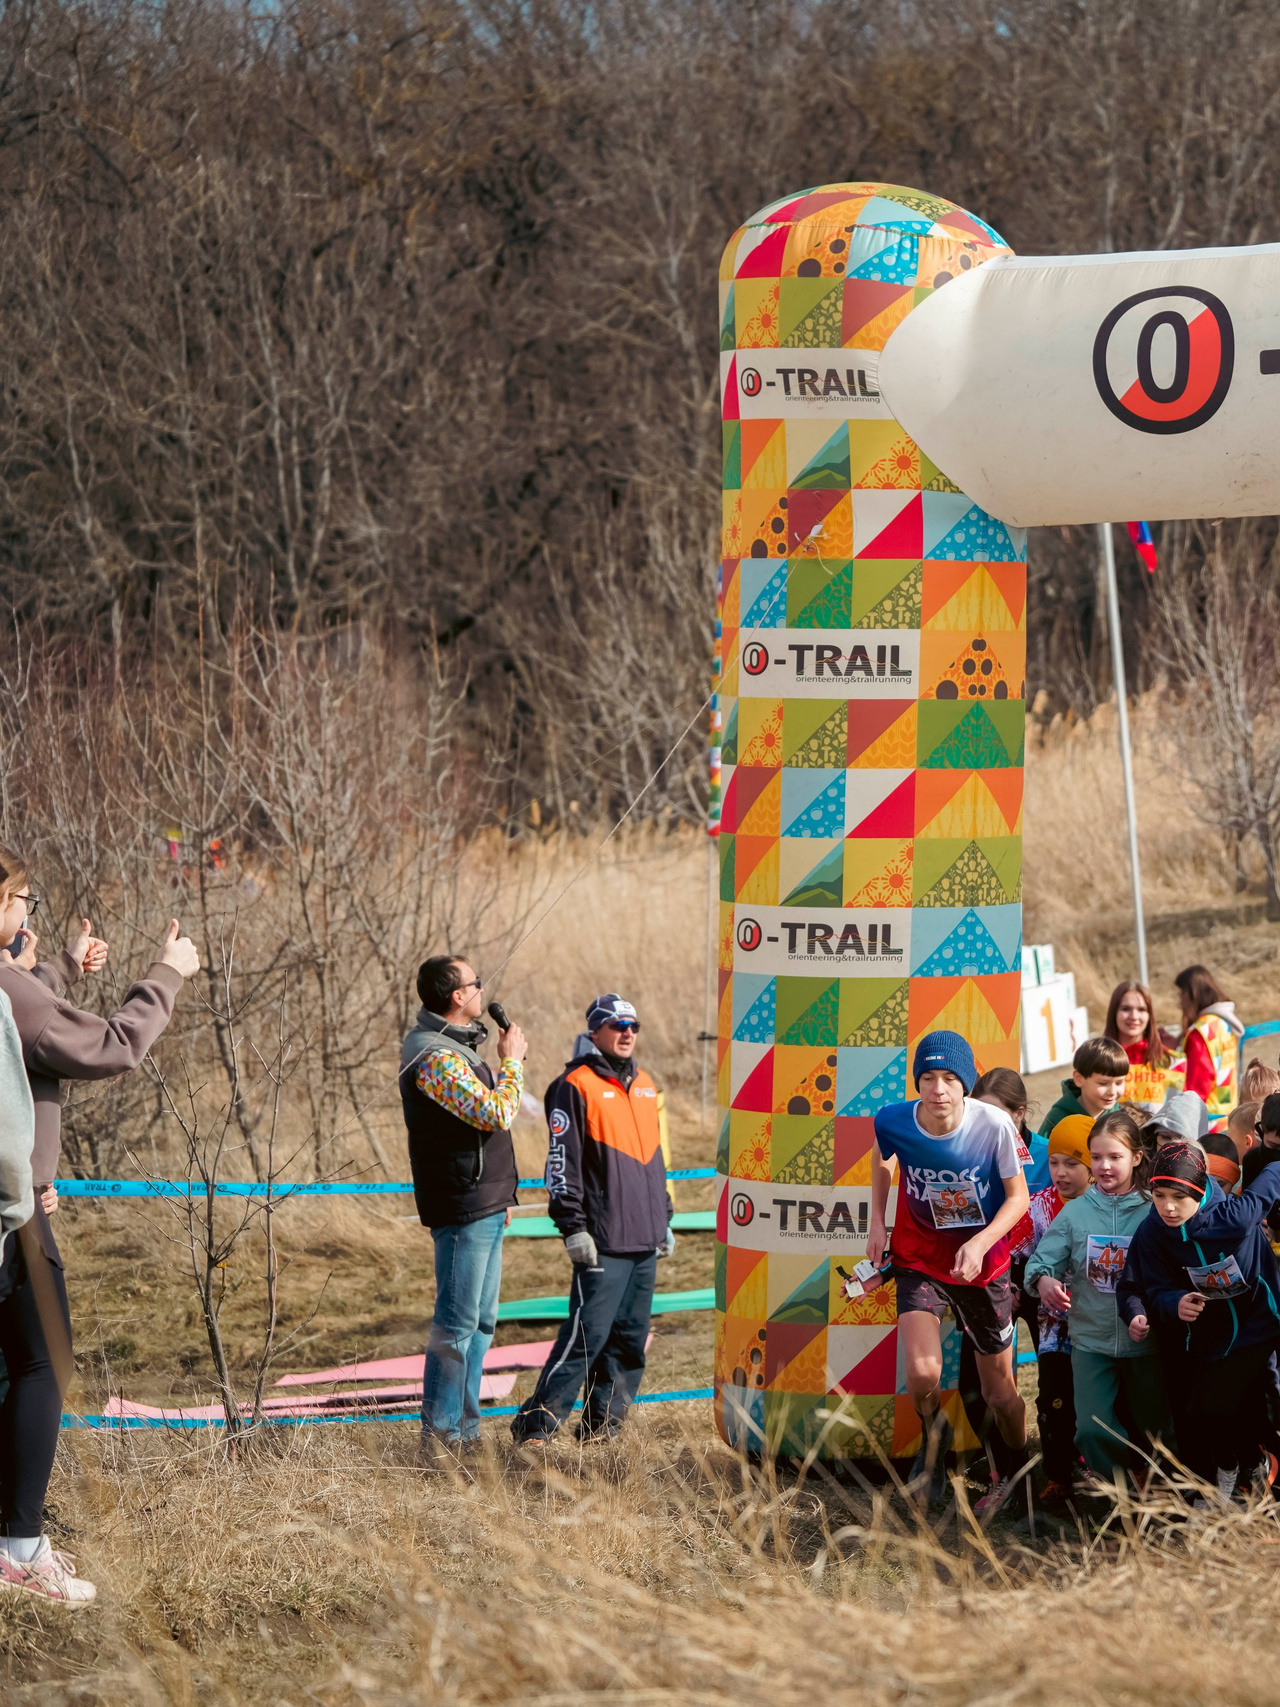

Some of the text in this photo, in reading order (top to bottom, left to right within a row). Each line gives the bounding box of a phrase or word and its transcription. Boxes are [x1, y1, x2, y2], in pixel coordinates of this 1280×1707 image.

[795, 675, 912, 685] orienteering&trailrunning
[787, 953, 903, 964] orienteering&trailrunning
[1040, 998, 1056, 1062] 1
[1124, 1071, 1166, 1084] ОНТЕР
[907, 1165, 981, 1183] КРОСС
[939, 1191, 968, 1208] 56
[1097, 1248, 1126, 1269] 44
[1205, 1269, 1232, 1288] 41
